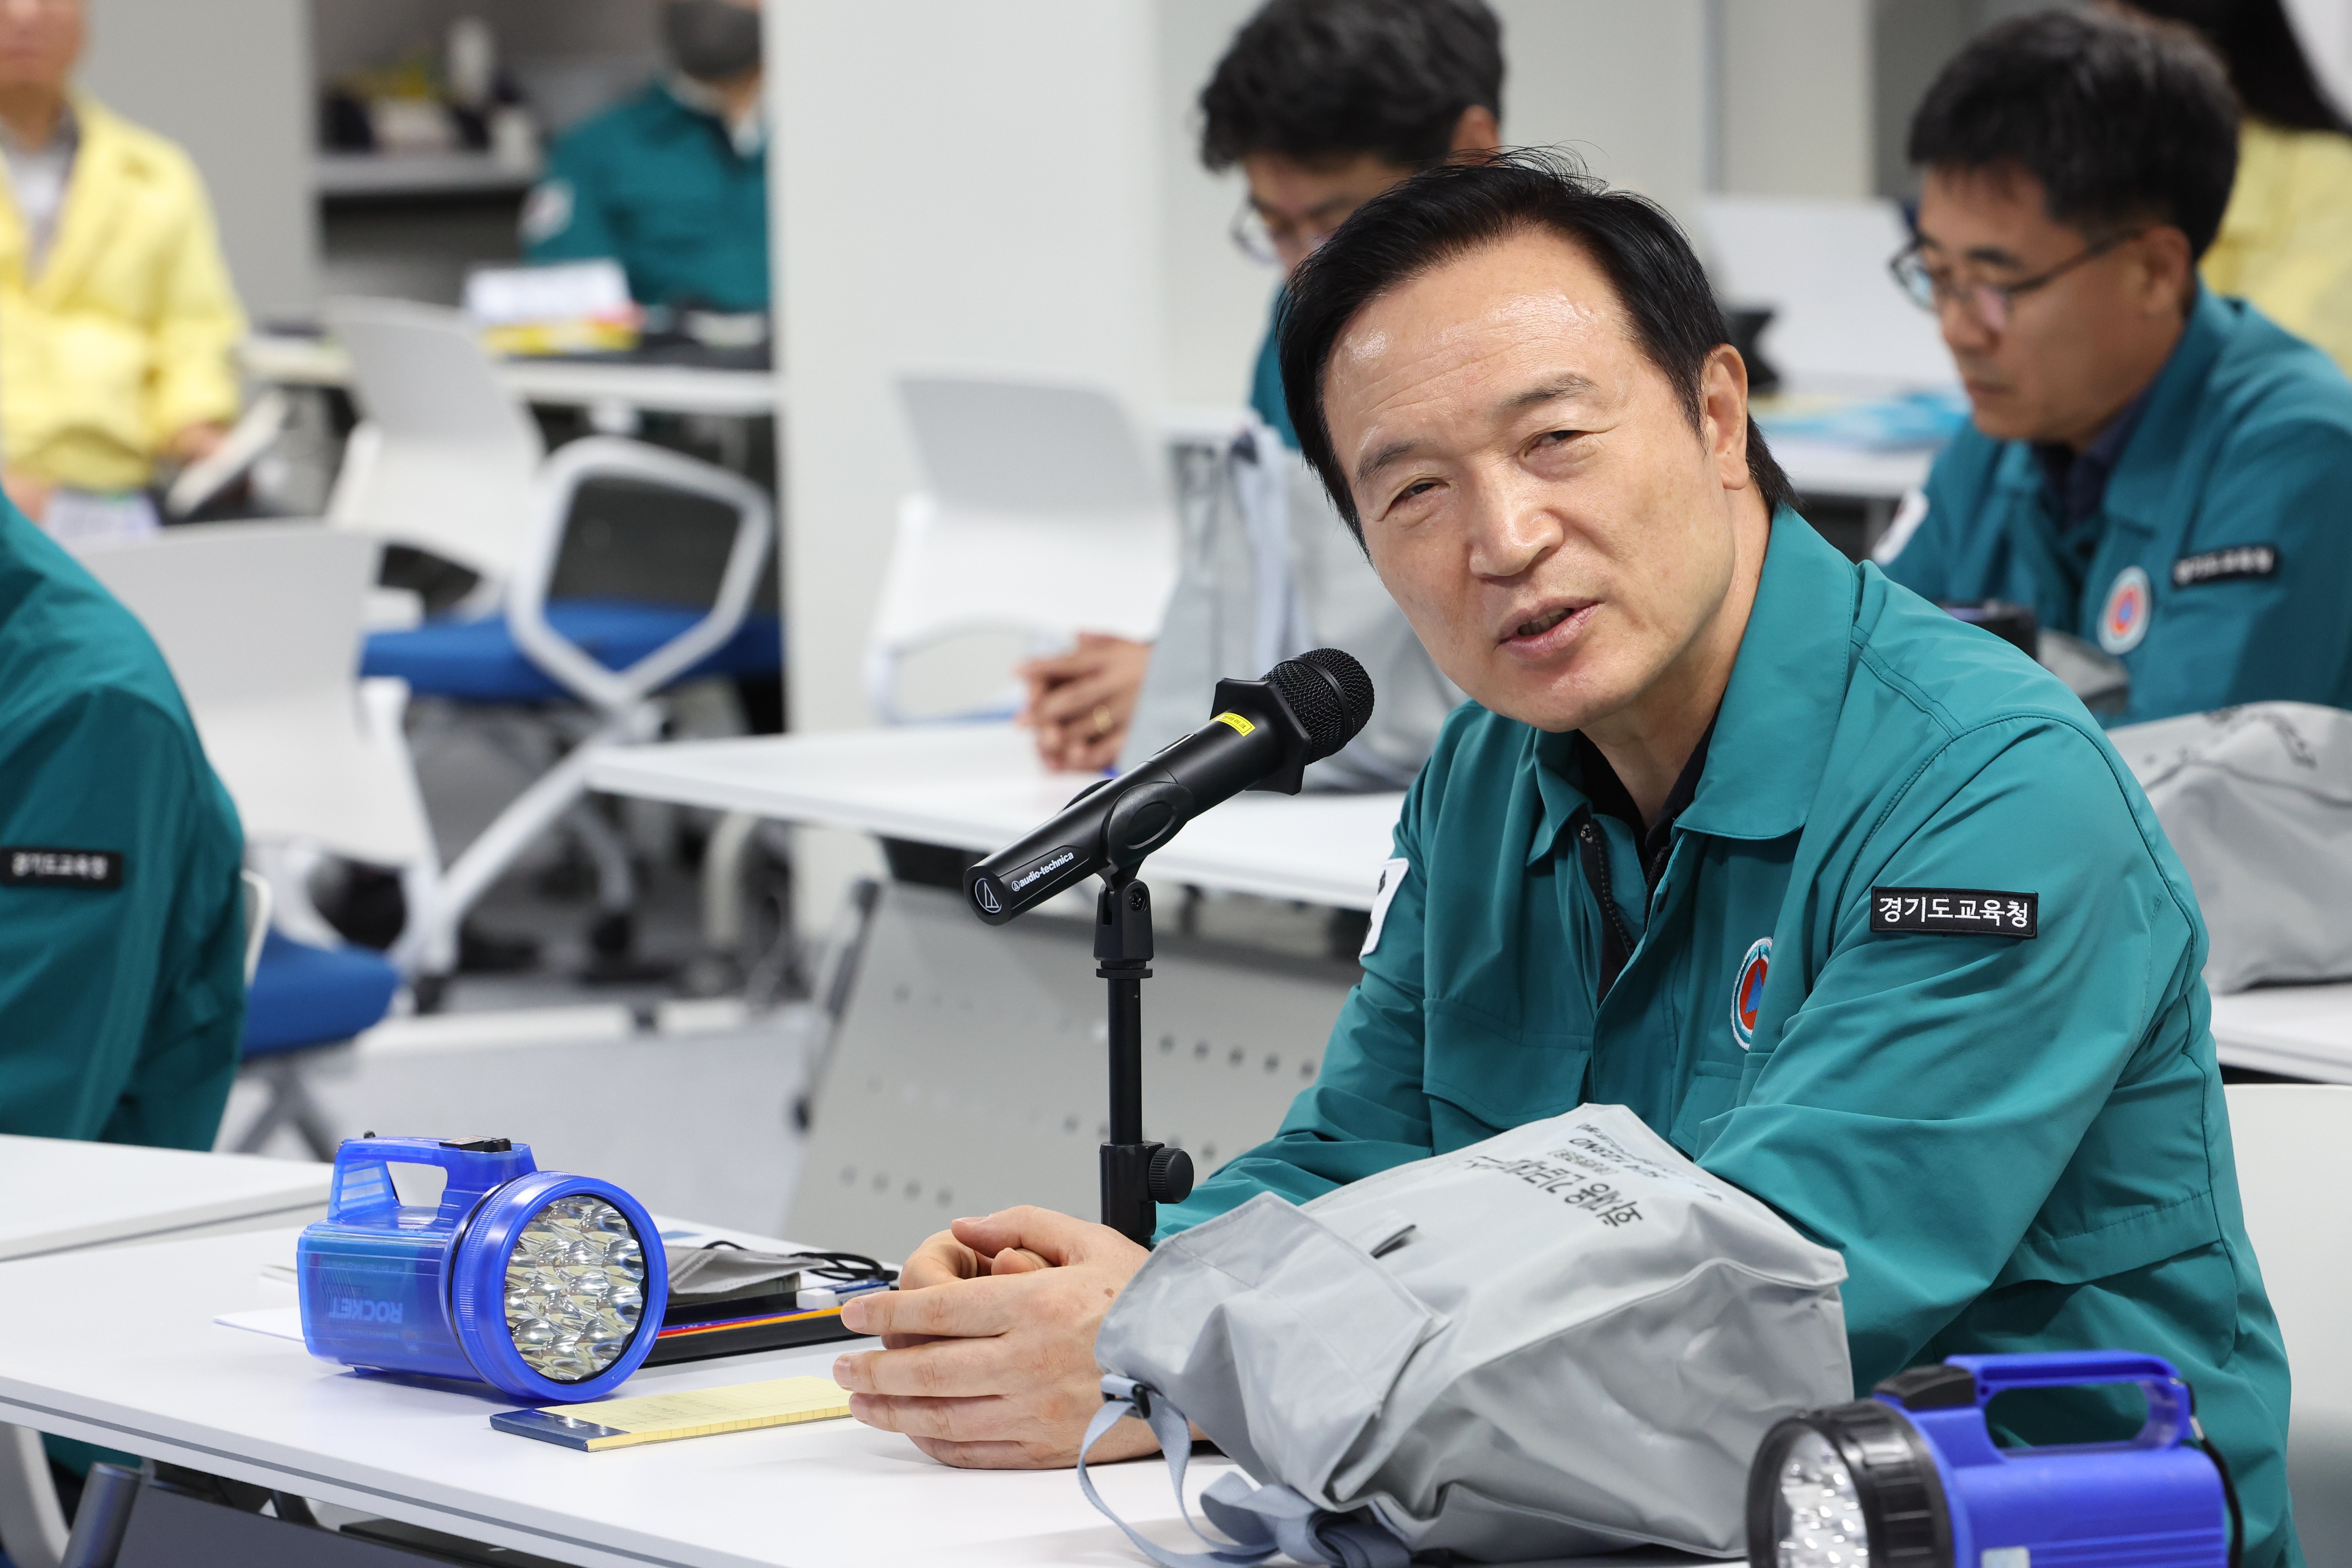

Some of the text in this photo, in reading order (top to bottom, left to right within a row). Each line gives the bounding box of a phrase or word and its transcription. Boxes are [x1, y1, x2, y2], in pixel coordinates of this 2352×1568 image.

[1019, 852, 1074, 887] audio-technica
[1879, 897, 2028, 928] 경기도교육청
[329, 1298, 403, 1324] ROCKET
